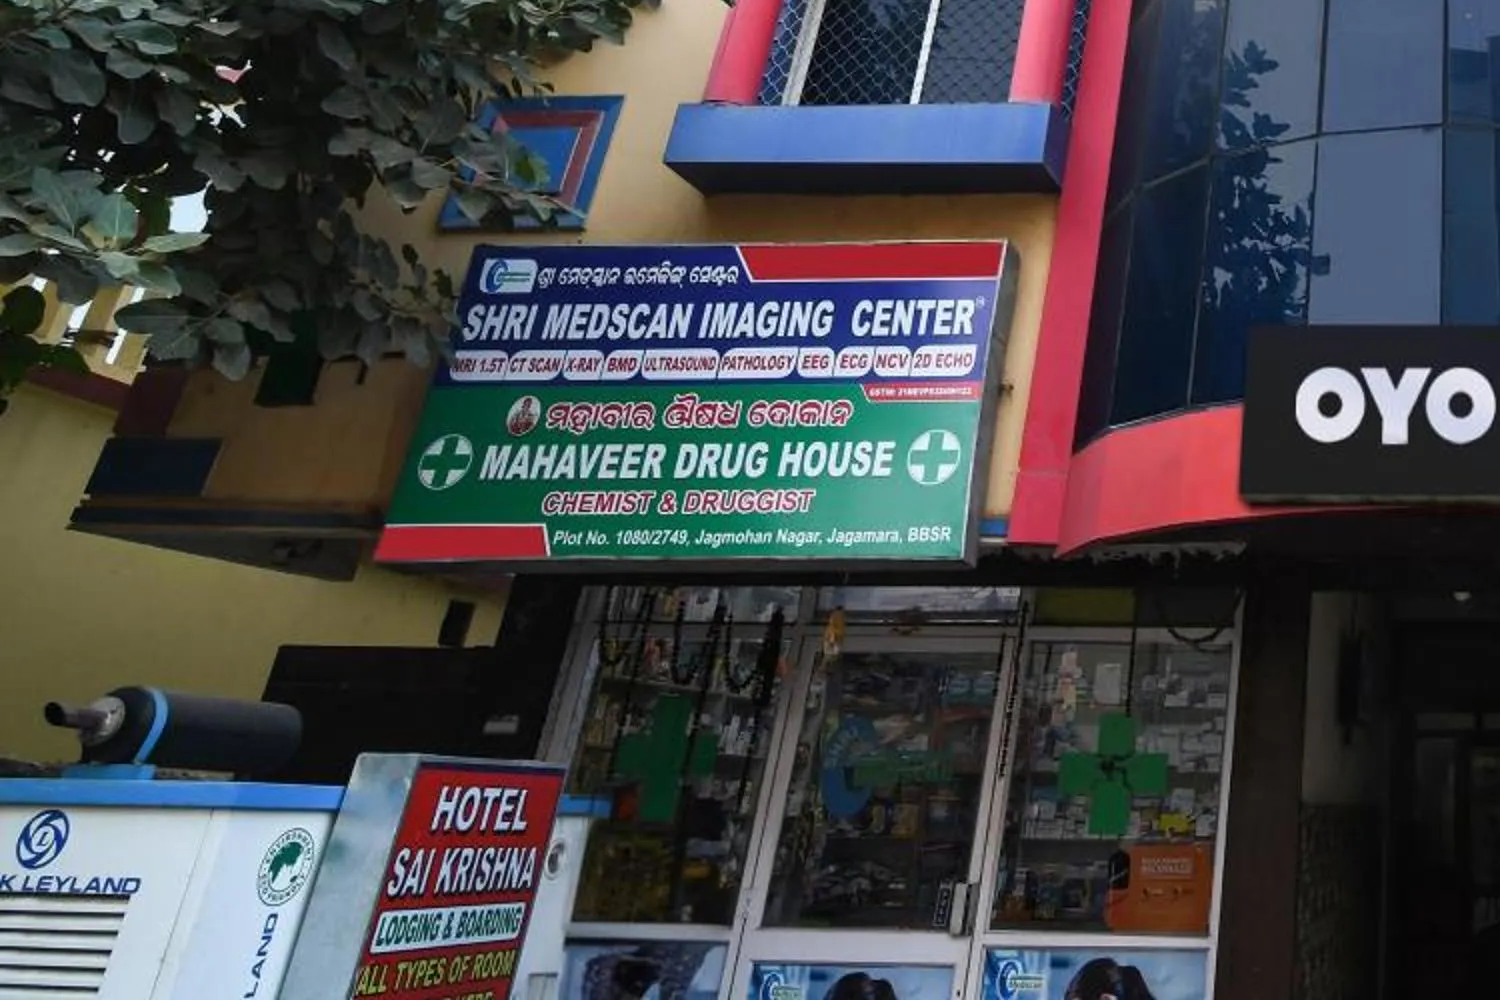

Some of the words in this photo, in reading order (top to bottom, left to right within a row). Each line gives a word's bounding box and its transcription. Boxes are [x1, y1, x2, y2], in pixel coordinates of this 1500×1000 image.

[463, 303, 539, 341] SHRI
[541, 302, 695, 340] MEDSCAN
[699, 300, 836, 338] IMAGING
[851, 299, 977, 336] CENTER
[453, 358, 477, 372] MRI
[479, 356, 506, 373] 1.5T
[509, 356, 529, 372] CT
[530, 356, 562, 373] SCAN
[565, 356, 603, 372] X-RAY
[607, 356, 638, 372] BMD
[643, 355, 717, 372] ULTRASOUND
[720, 353, 796, 371] PATHOLOGY
[801, 353, 830, 370] EEG
[839, 352, 869, 370] ECG
[875, 351, 909, 370] NCV
[913, 351, 934, 369] 2D
[935, 350, 974, 369] ECHO
[1295, 366, 1497, 445] OYO
[479, 443, 667, 480] MAHAVEER
[673, 442, 769, 479] DRUG
[777, 440, 897, 478] HOUSE
[542, 490, 657, 516] CHEMIST
[658, 491, 678, 516] &
[683, 488, 816, 515] DRUGGIST
[552, 530, 583, 546] Plot
[585, 530, 610, 546] No.
[695, 528, 772, 549] Jagmohan
[907, 525, 953, 543] BBSR
[431, 786, 529, 832] HOTEL
[387, 847, 437, 897] SAI
[434, 847, 538, 894] KRISHNA
[21, 874, 142, 894] LEYLAND
[375, 911, 442, 947] LODGING
[442, 912, 454, 940] &
[456, 906, 524, 937] BOARDING
[355, 964, 389, 996] ALL
[393, 958, 448, 989] TYPES
[448, 954, 471, 984] OF
[474, 950, 516, 978] ROOM
